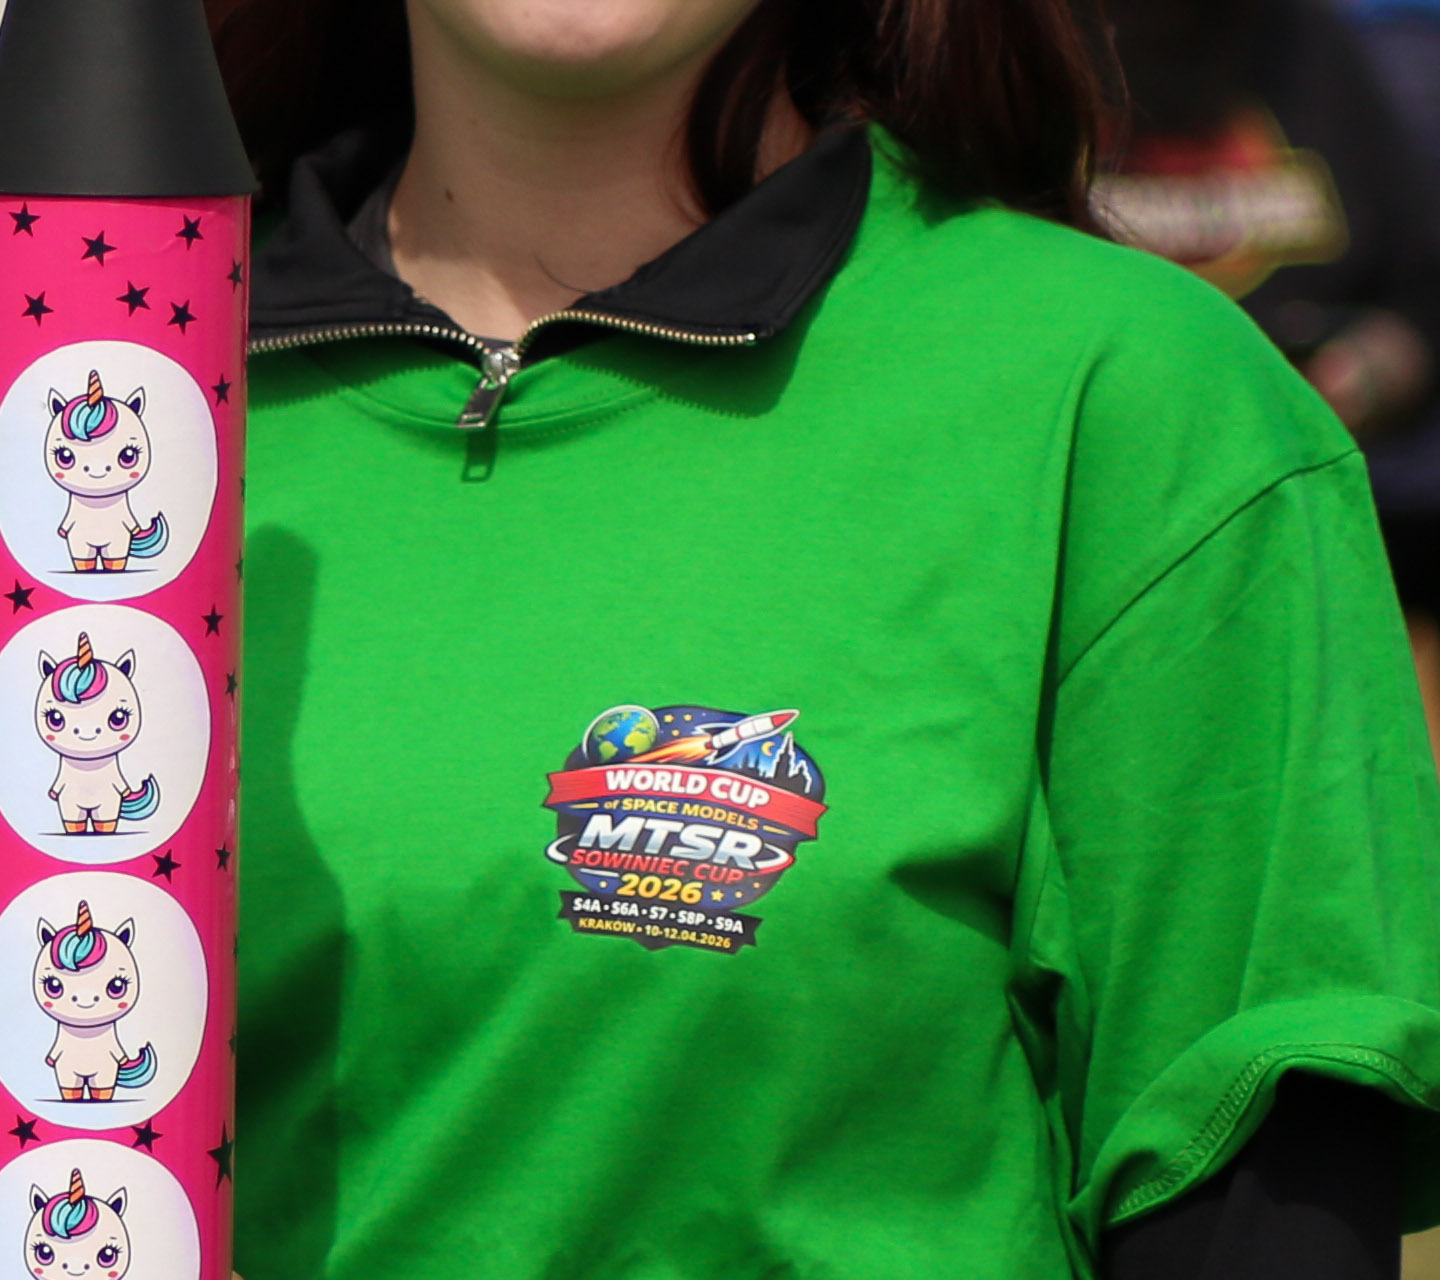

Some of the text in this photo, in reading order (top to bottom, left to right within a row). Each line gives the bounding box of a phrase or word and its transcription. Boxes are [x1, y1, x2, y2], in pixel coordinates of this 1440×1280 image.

[605, 769, 770, 809] WORLD CUP
[604, 797, 759, 830] of SPACE MODELS
[578, 814, 763, 871] MTSR
[570, 848, 744, 885] SOWINIEC CUP
[617, 873, 703, 904] 2026
[572, 897, 743, 934] S4A S6A S7 S8P S9A
[644, 925, 732, 948] 10-12.04.2026
